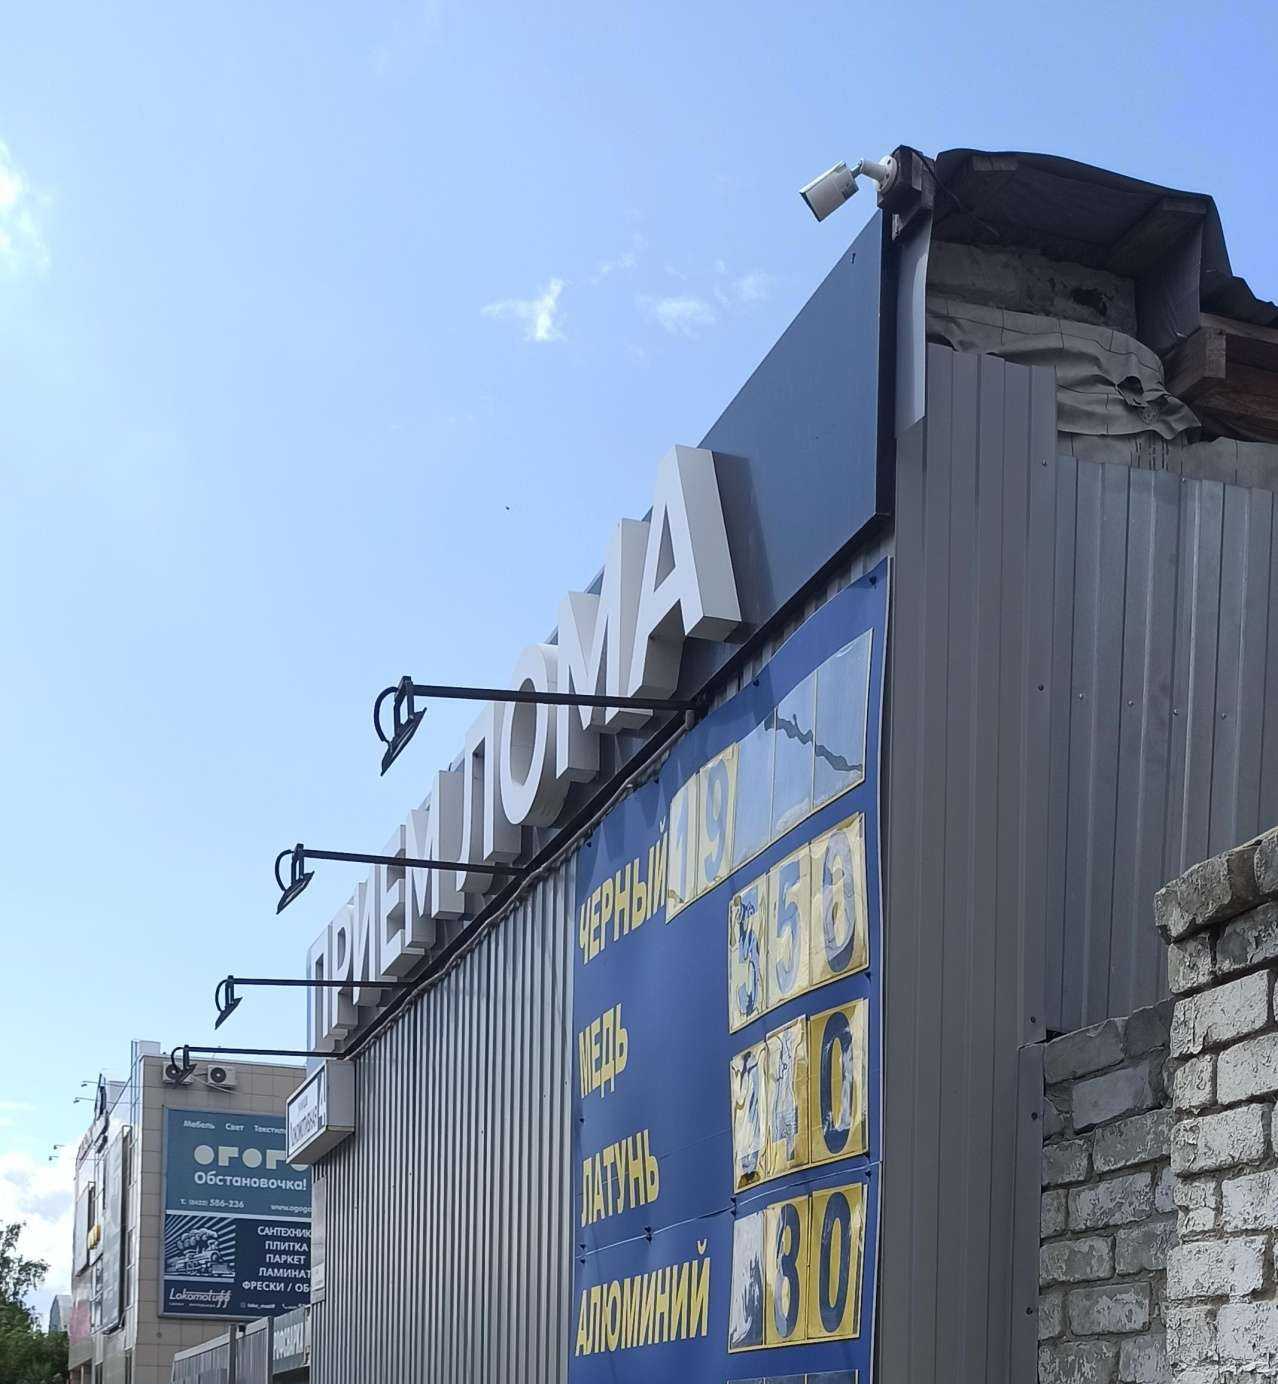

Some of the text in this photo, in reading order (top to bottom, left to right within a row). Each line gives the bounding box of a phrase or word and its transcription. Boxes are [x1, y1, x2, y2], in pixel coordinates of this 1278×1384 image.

[306, 444, 741, 1056] ПРИЕМ ЛОМА
[579, 820, 669, 965] ЧЕРНЫЙ
[579, 1003, 628, 1098] МЕДЬ
[184, 1120, 215, 1130] Мебель
[225, 1122, 244, 1132] Свет
[194, 1144, 309, 1172] ОГОГ
[194, 1171, 307, 1191] Обстановочка!
[580, 1130, 660, 1227] ЛАТУНЬ
[265, 1240, 309, 1252] ПЛИТКА
[265, 1254, 306, 1265] ПАРКЕТ
[258, 1267, 311, 1279] ЛАМИНАТ
[242, 1281, 285, 1292] ФРЕСКИ
[294, 1283, 312, 1293] ОБ
[575, 1238, 711, 1357] АЛЮМИНИЙ
